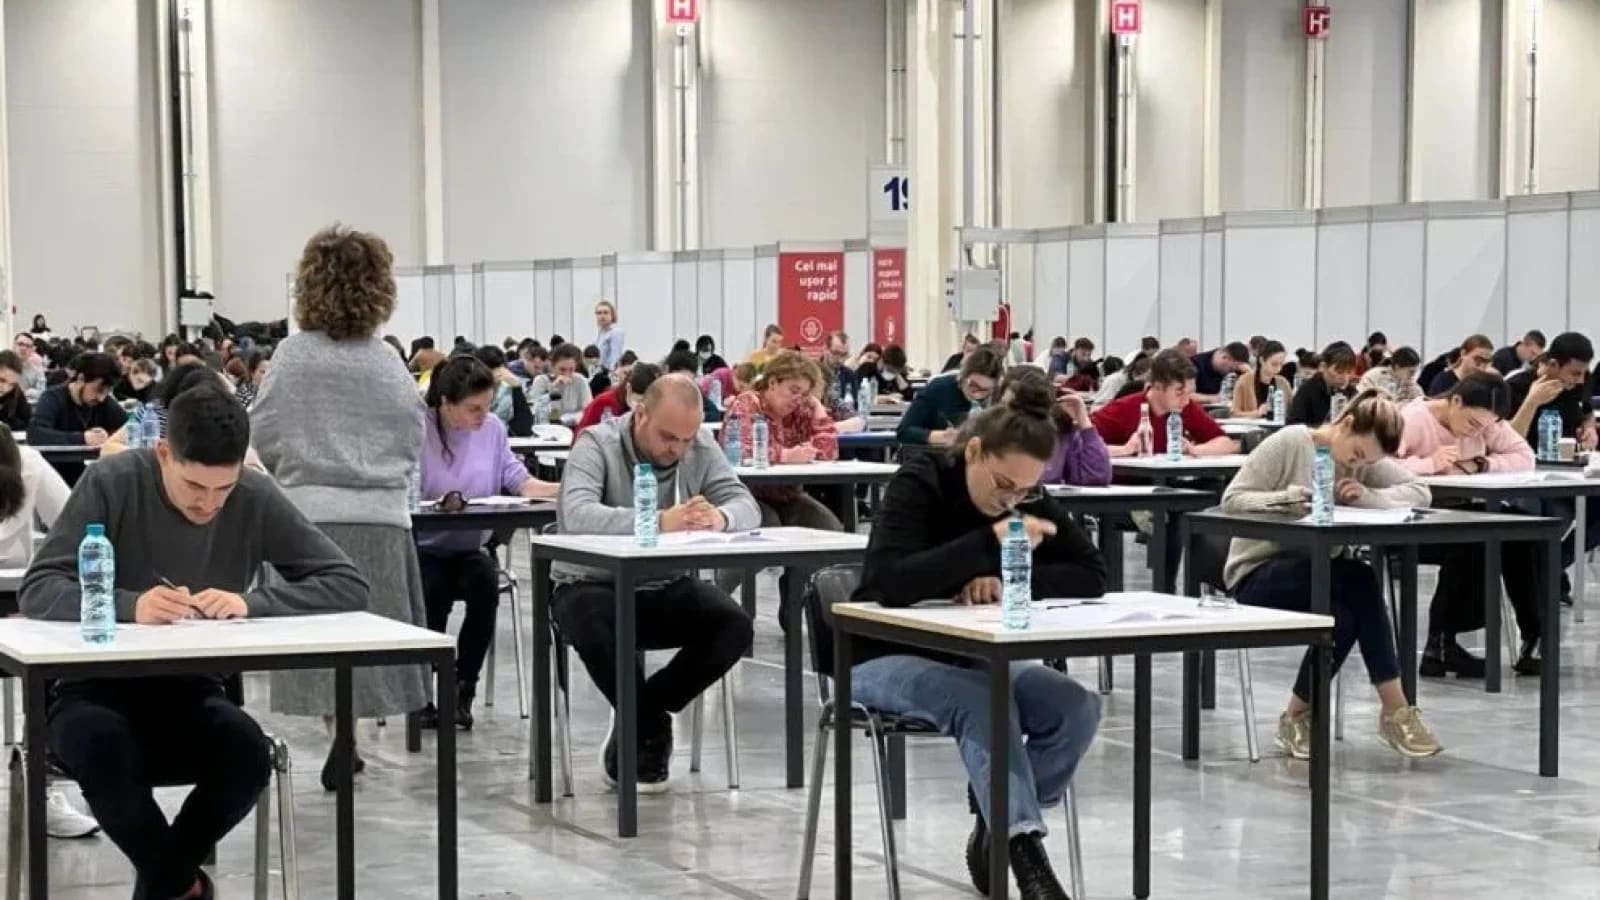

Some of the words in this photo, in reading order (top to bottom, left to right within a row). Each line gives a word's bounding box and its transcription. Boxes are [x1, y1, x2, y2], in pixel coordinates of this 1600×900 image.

[673, 0, 691, 17] H
[1118, 6, 1135, 28] H
[1309, 12, 1323, 33] H
[795, 260, 813, 272] Cel
[815, 258, 837, 272] mai
[807, 288, 837, 303] rapid
